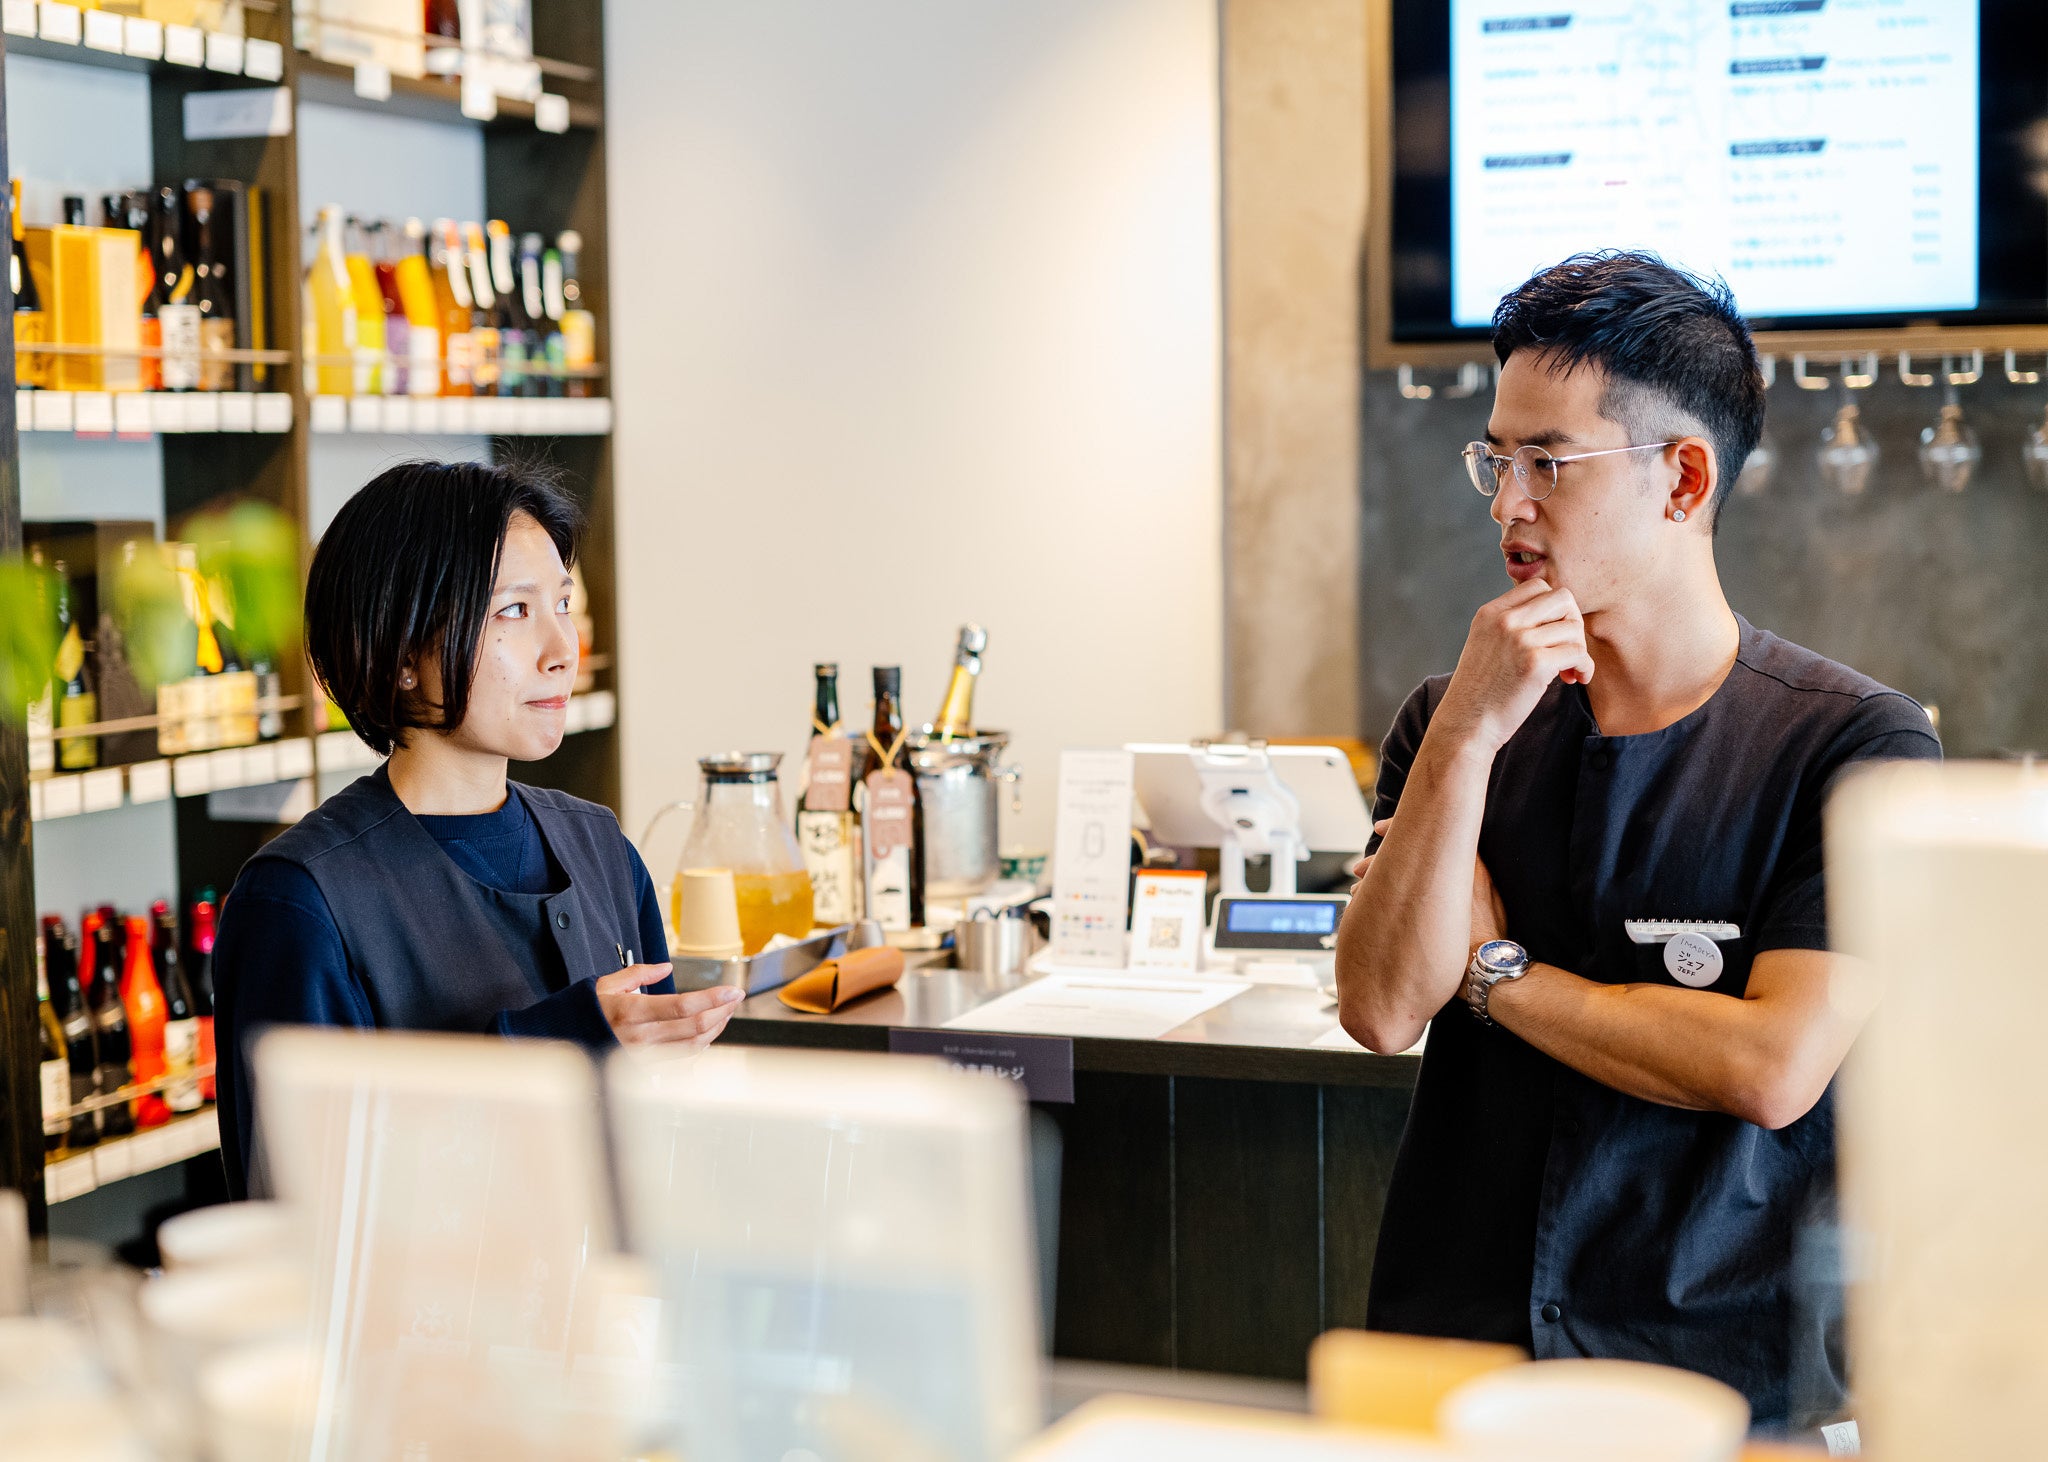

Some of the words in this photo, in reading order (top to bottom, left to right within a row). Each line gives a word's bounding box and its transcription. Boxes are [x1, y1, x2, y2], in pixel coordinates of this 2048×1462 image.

[1677, 950, 1705, 971] ジェフ
[1677, 965, 1696, 977] JEFF
